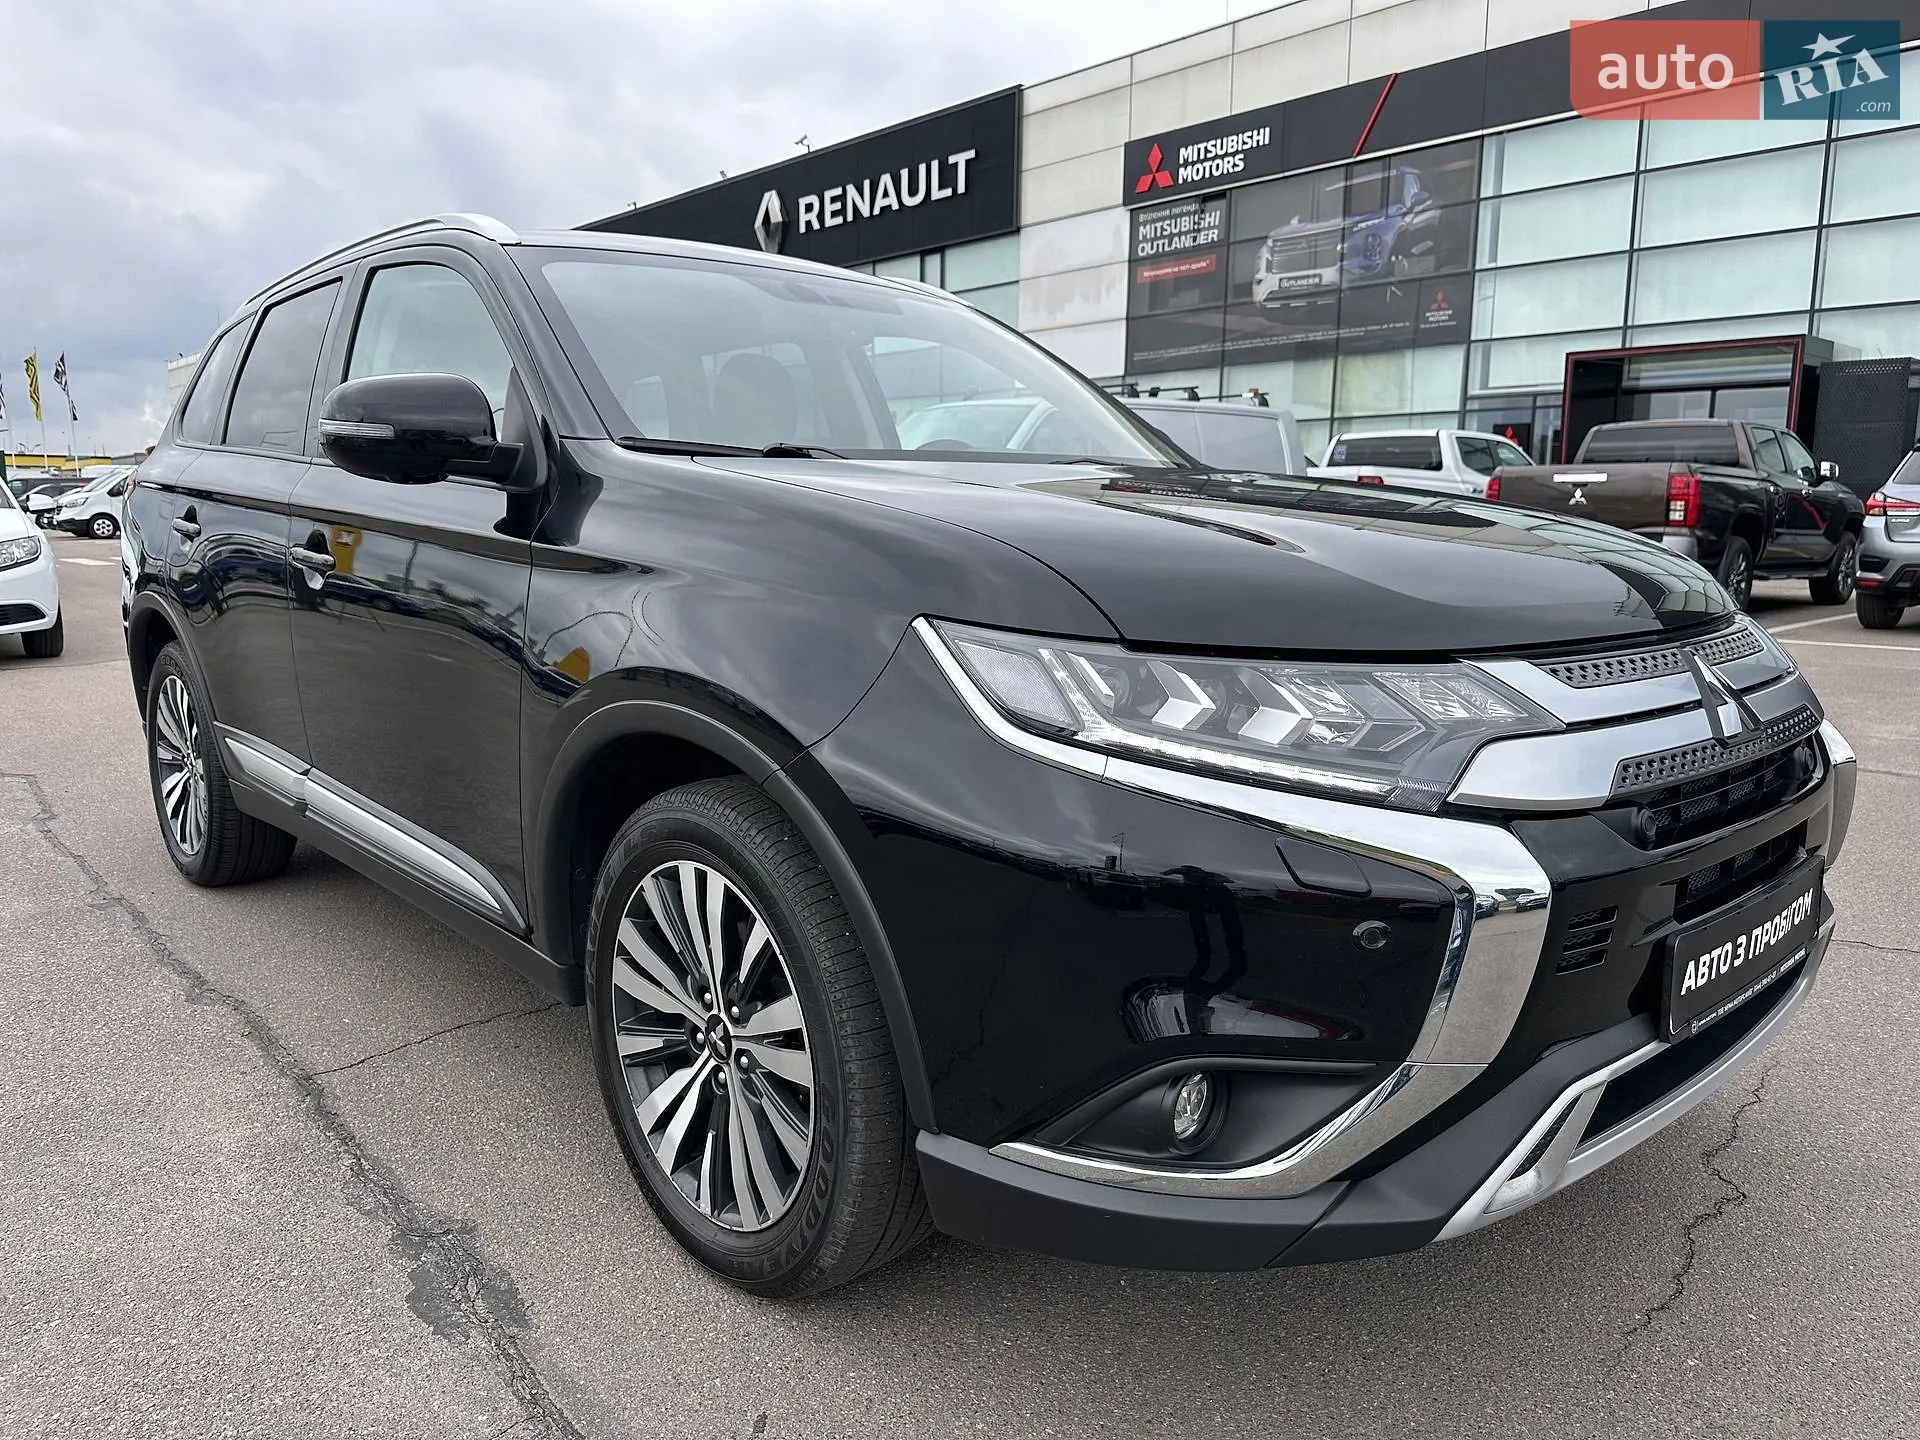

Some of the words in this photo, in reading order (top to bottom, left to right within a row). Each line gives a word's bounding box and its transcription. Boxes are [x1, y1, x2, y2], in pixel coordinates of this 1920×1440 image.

[1179, 127, 1270, 164] MITSUBISHI
[1178, 153, 1244, 184] MOTORS
[798, 149, 975, 234] RENAULT
[1138, 229, 1218, 256] OUTLANDER
[1681, 941, 1732, 995] АВТО
[1749, 888, 1813, 959] ПРОБІГОМ
